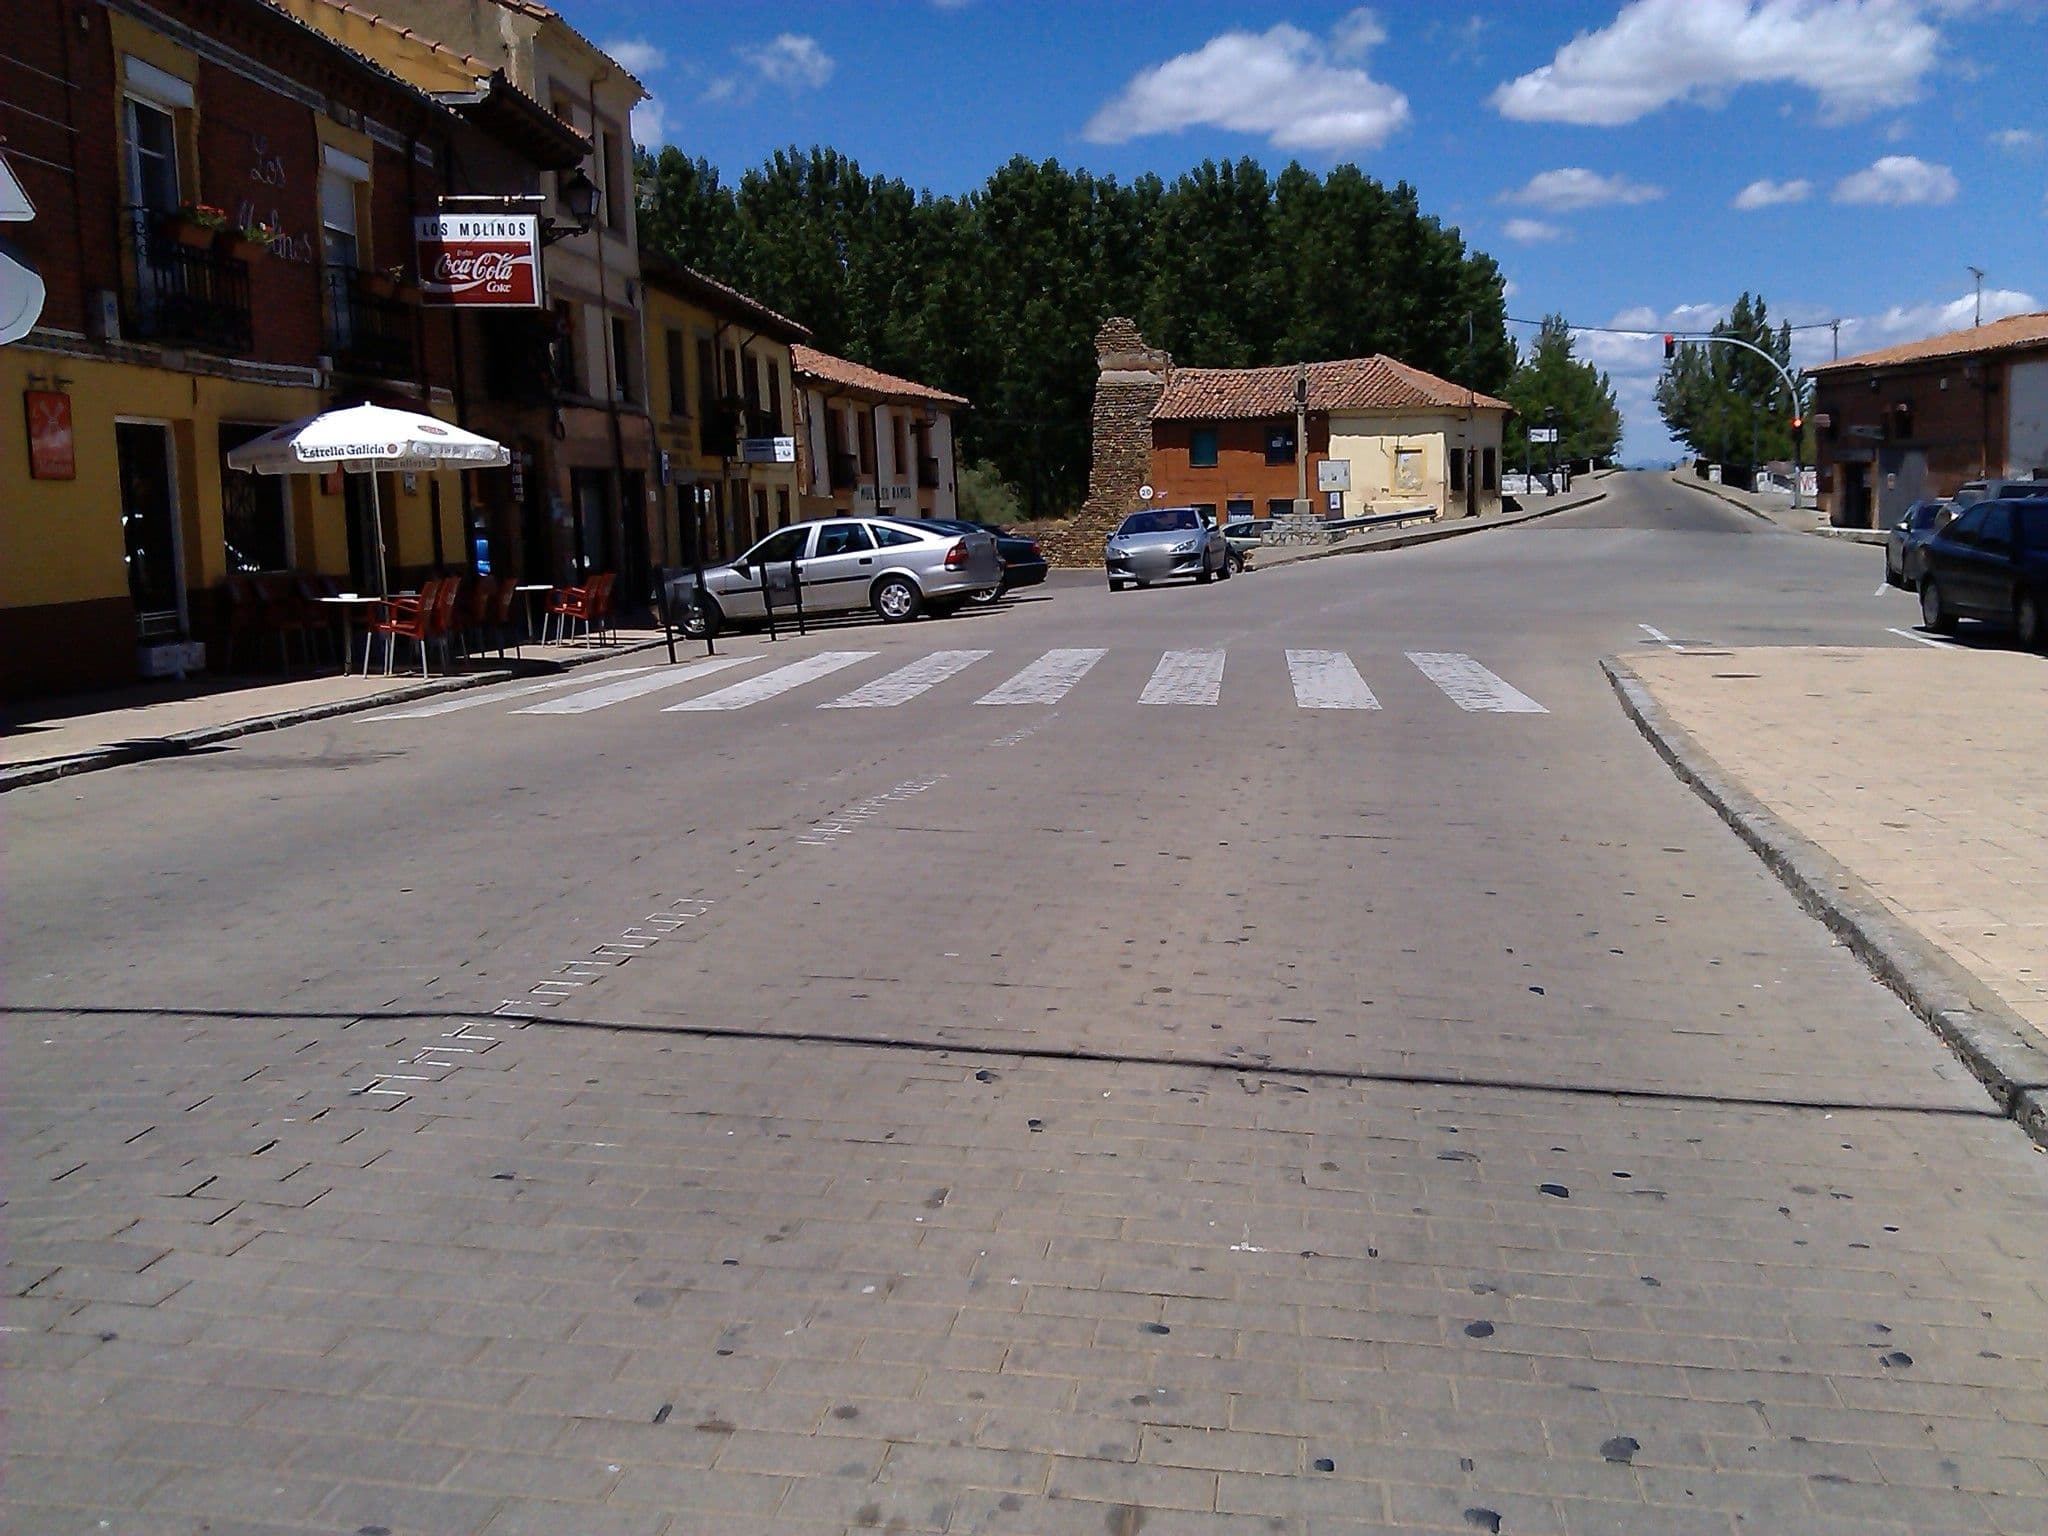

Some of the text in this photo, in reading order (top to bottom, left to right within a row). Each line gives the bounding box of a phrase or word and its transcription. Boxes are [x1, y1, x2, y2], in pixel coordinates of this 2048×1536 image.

[252, 136, 287, 187] Los
[423, 223, 526, 236] LOS MOLINOS
[434, 252, 513, 280] Coca-Cola
[487, 281, 512, 292] Coke
[302, 444, 385, 458] Estrella Galicia
